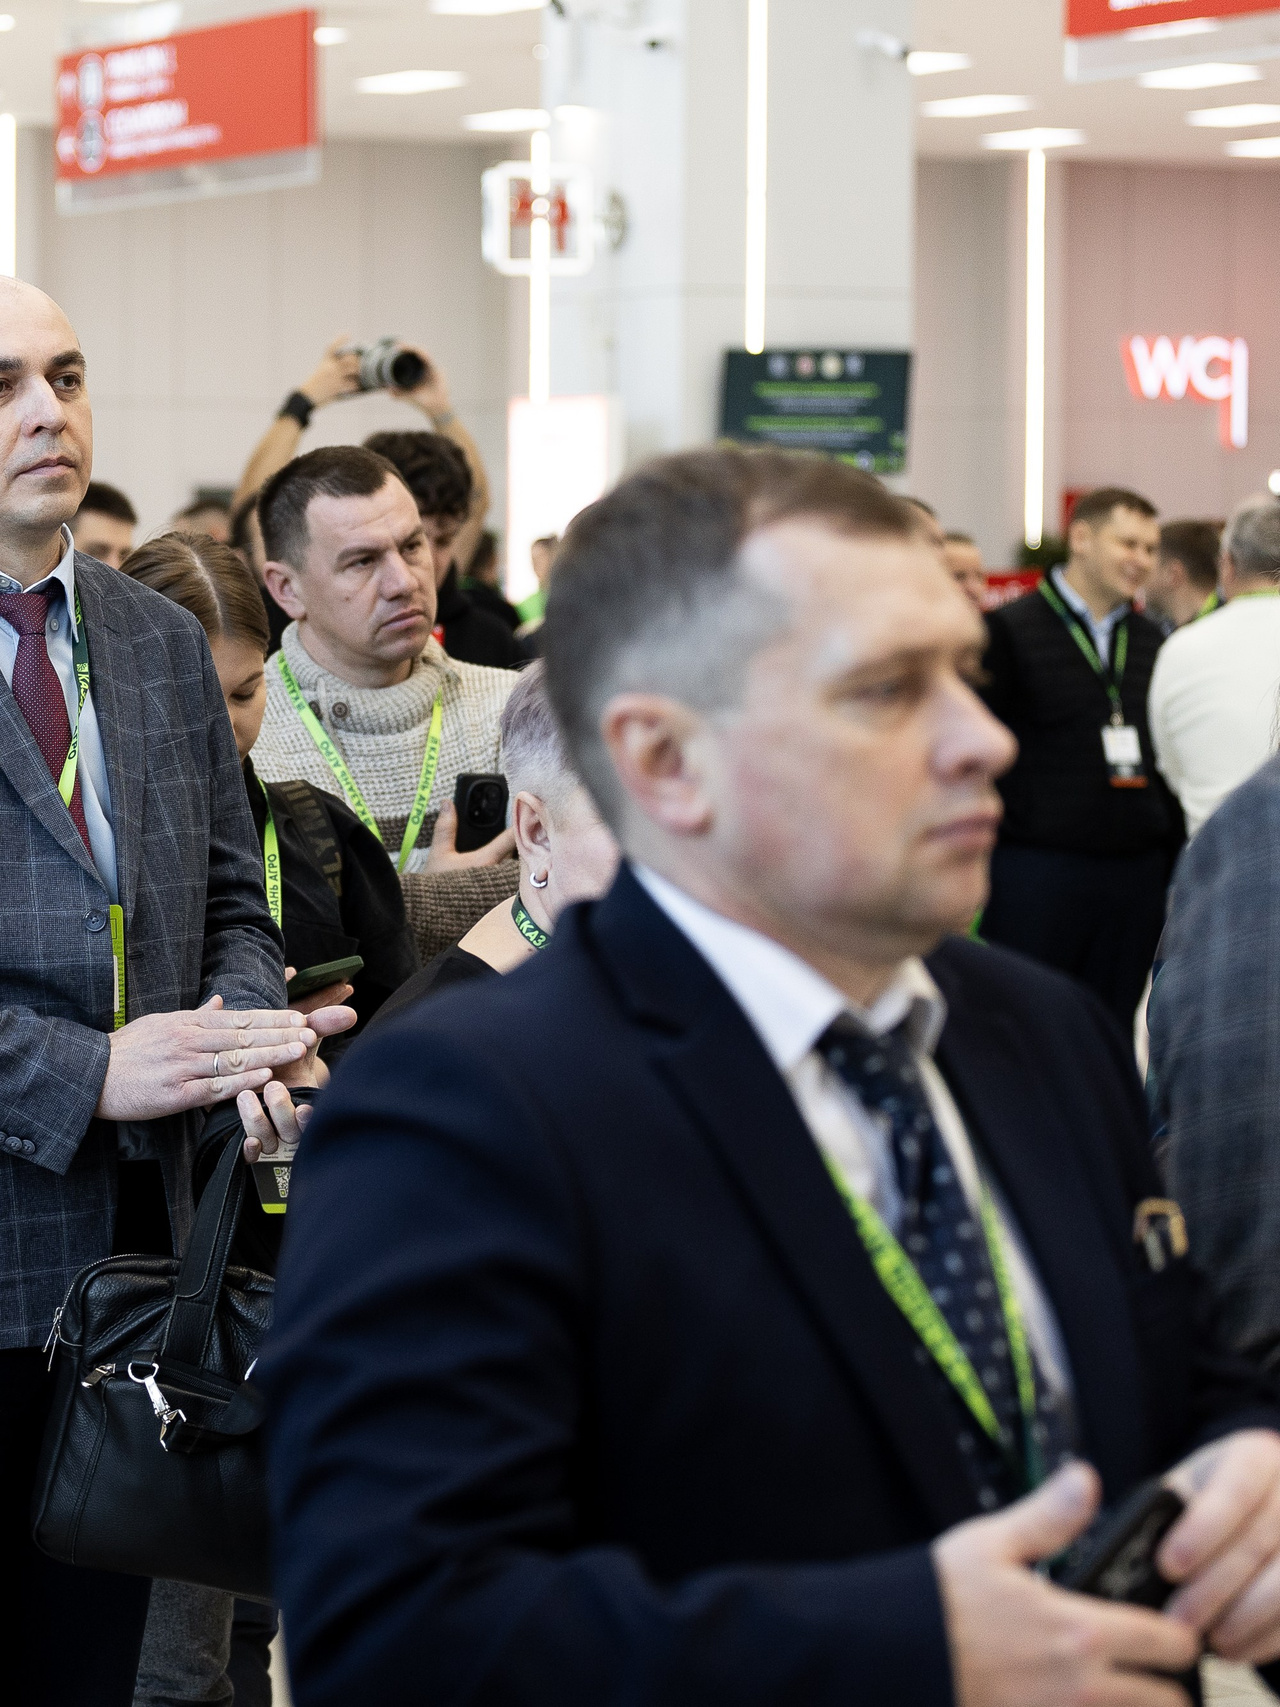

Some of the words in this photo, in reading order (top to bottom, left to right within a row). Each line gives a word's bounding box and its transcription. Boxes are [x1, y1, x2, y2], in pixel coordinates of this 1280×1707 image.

[320, 740, 342, 769] АГРО
[411, 793, 426, 826] АГРО
[267, 853, 278, 878] АГРО
[269, 884, 279, 923] АЗАНЬ
[520, 920, 546, 946] КАЗ
